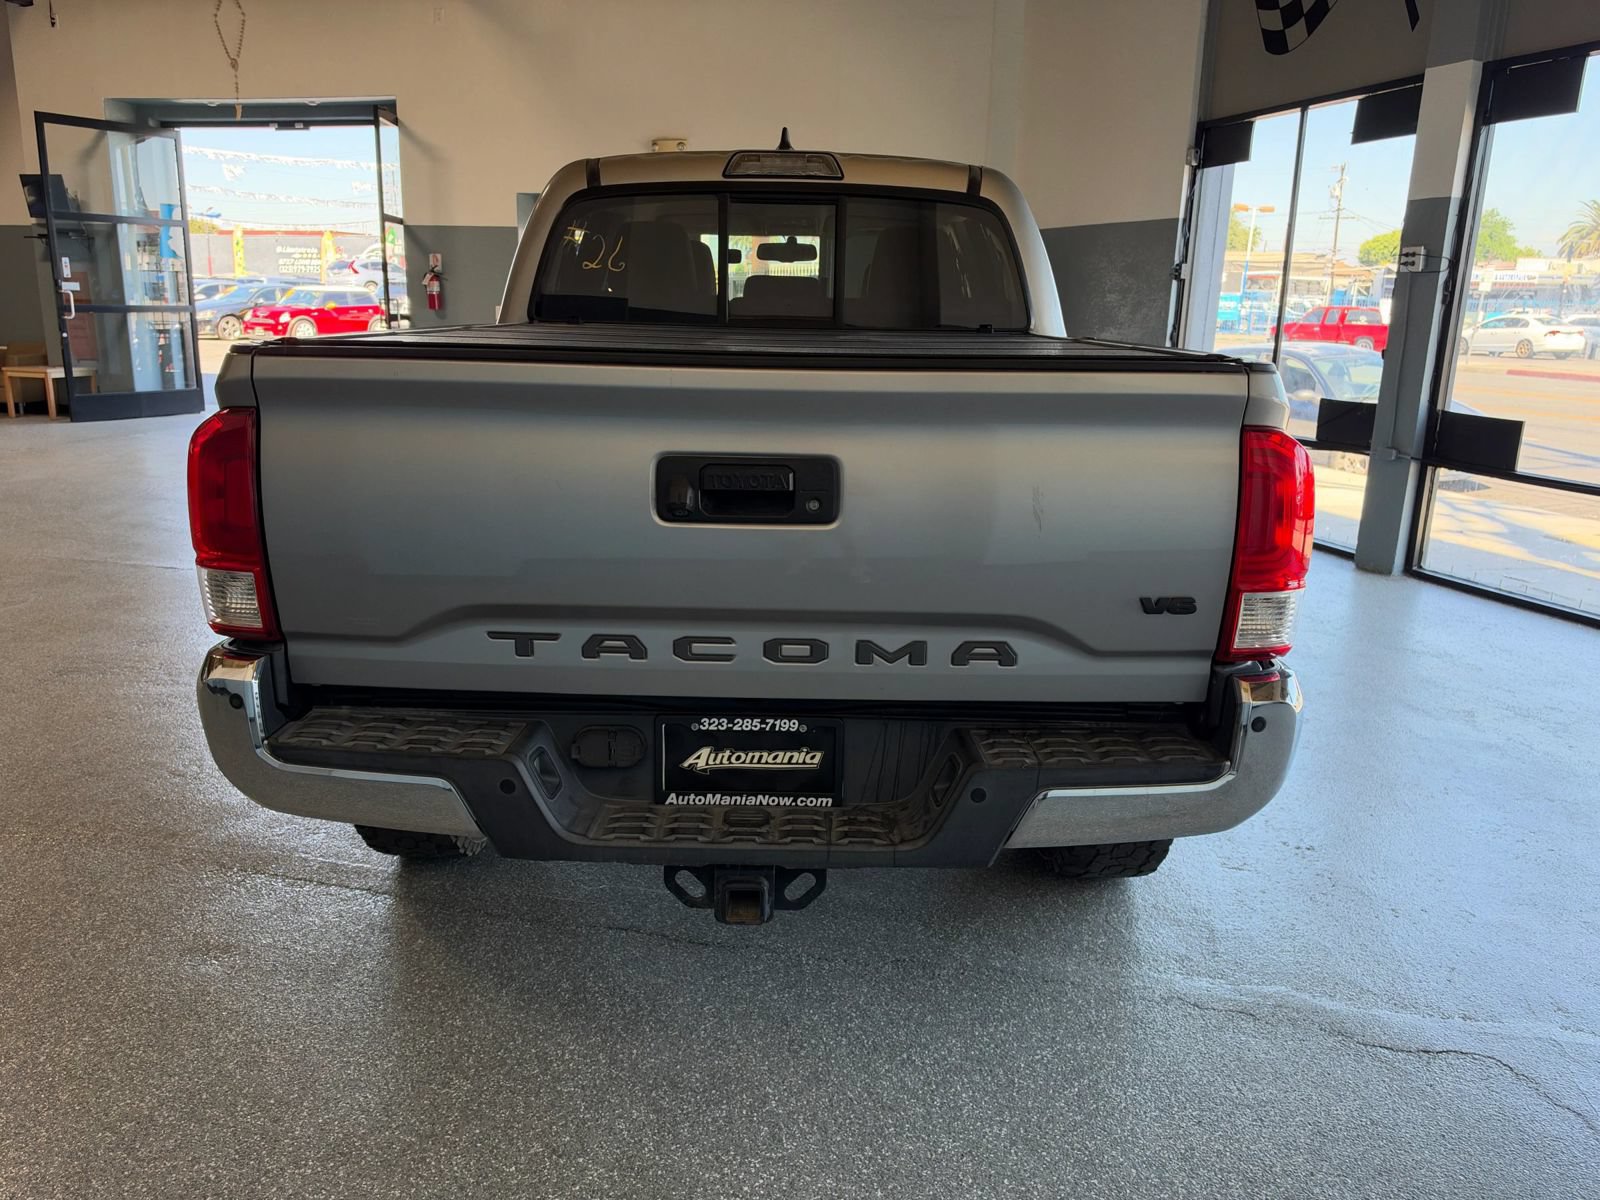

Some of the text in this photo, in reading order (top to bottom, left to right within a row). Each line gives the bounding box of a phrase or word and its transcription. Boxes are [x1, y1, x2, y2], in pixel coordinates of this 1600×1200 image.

[709, 472, 789, 490] TOYOTA
[1138, 597, 1197, 615] V6
[486, 630, 1018, 667] TACOMA
[699, 717, 799, 732] 323-285-7199
[680, 746, 824, 772] Automania
[665, 792, 833, 808] AutoManiaNow.com
